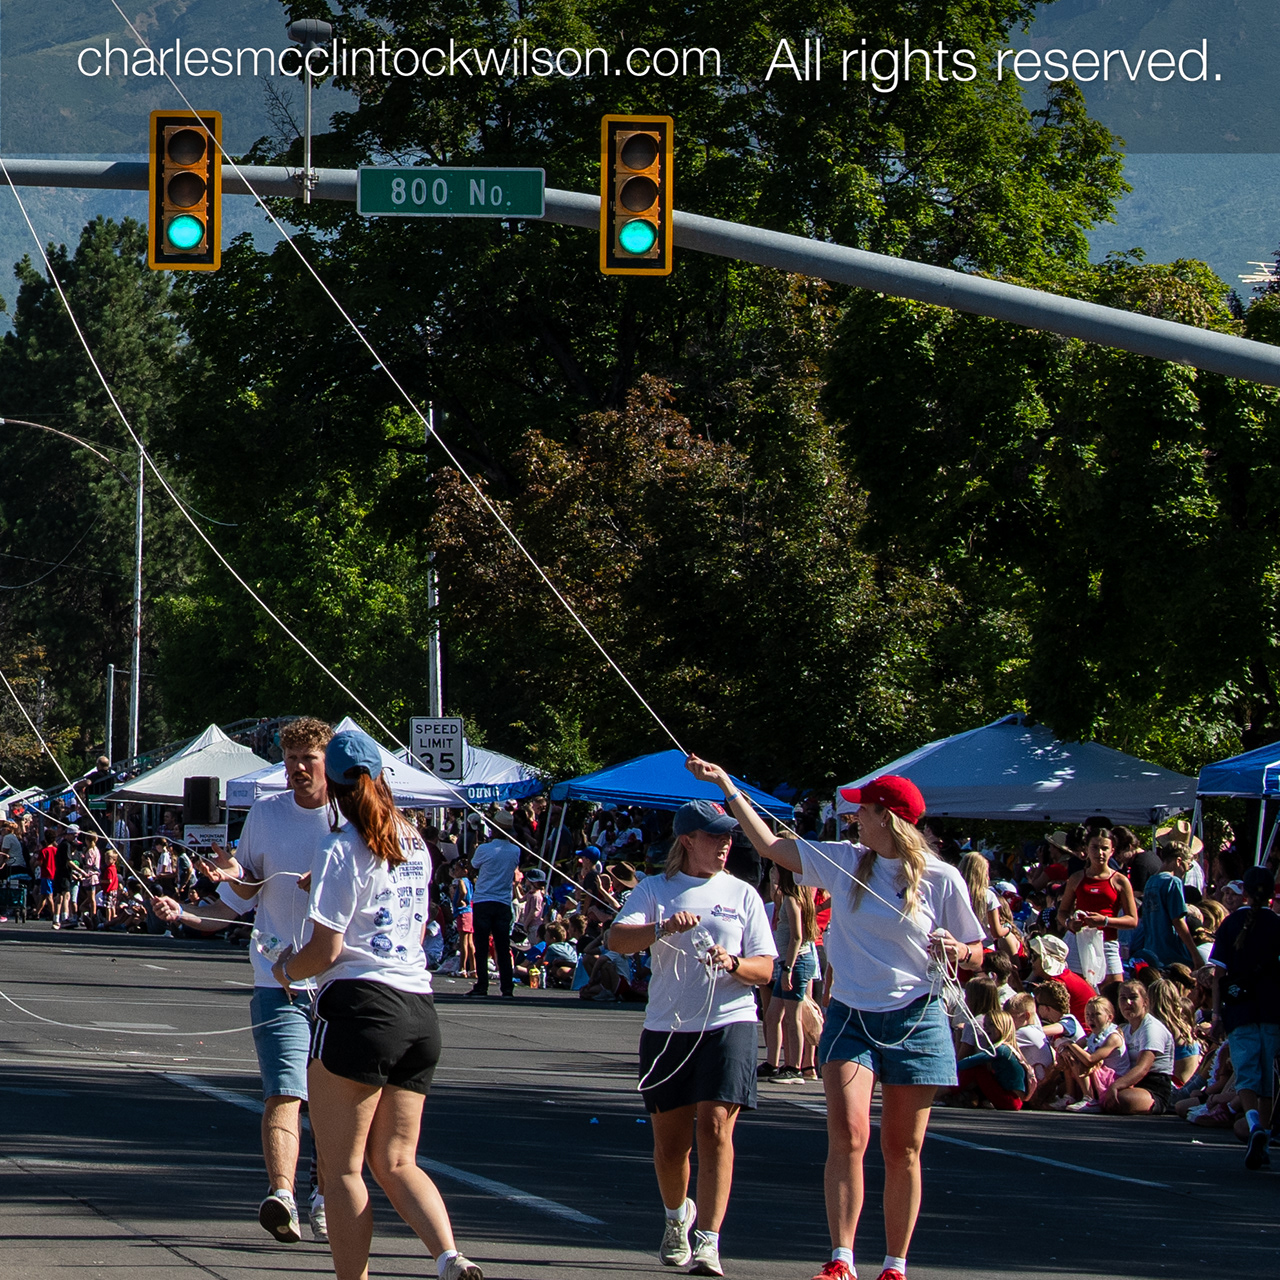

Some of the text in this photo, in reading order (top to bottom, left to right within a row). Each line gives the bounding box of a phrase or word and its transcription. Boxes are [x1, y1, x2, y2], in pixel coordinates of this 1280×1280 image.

[391, 177, 512, 207] 800 No.
[415, 724, 459, 735] SPEED
[419, 738, 454, 749] LIMIT
[419, 752, 456, 773] 35
[467, 786, 500, 799] OUNG
[396, 886, 413, 898] SUPER
